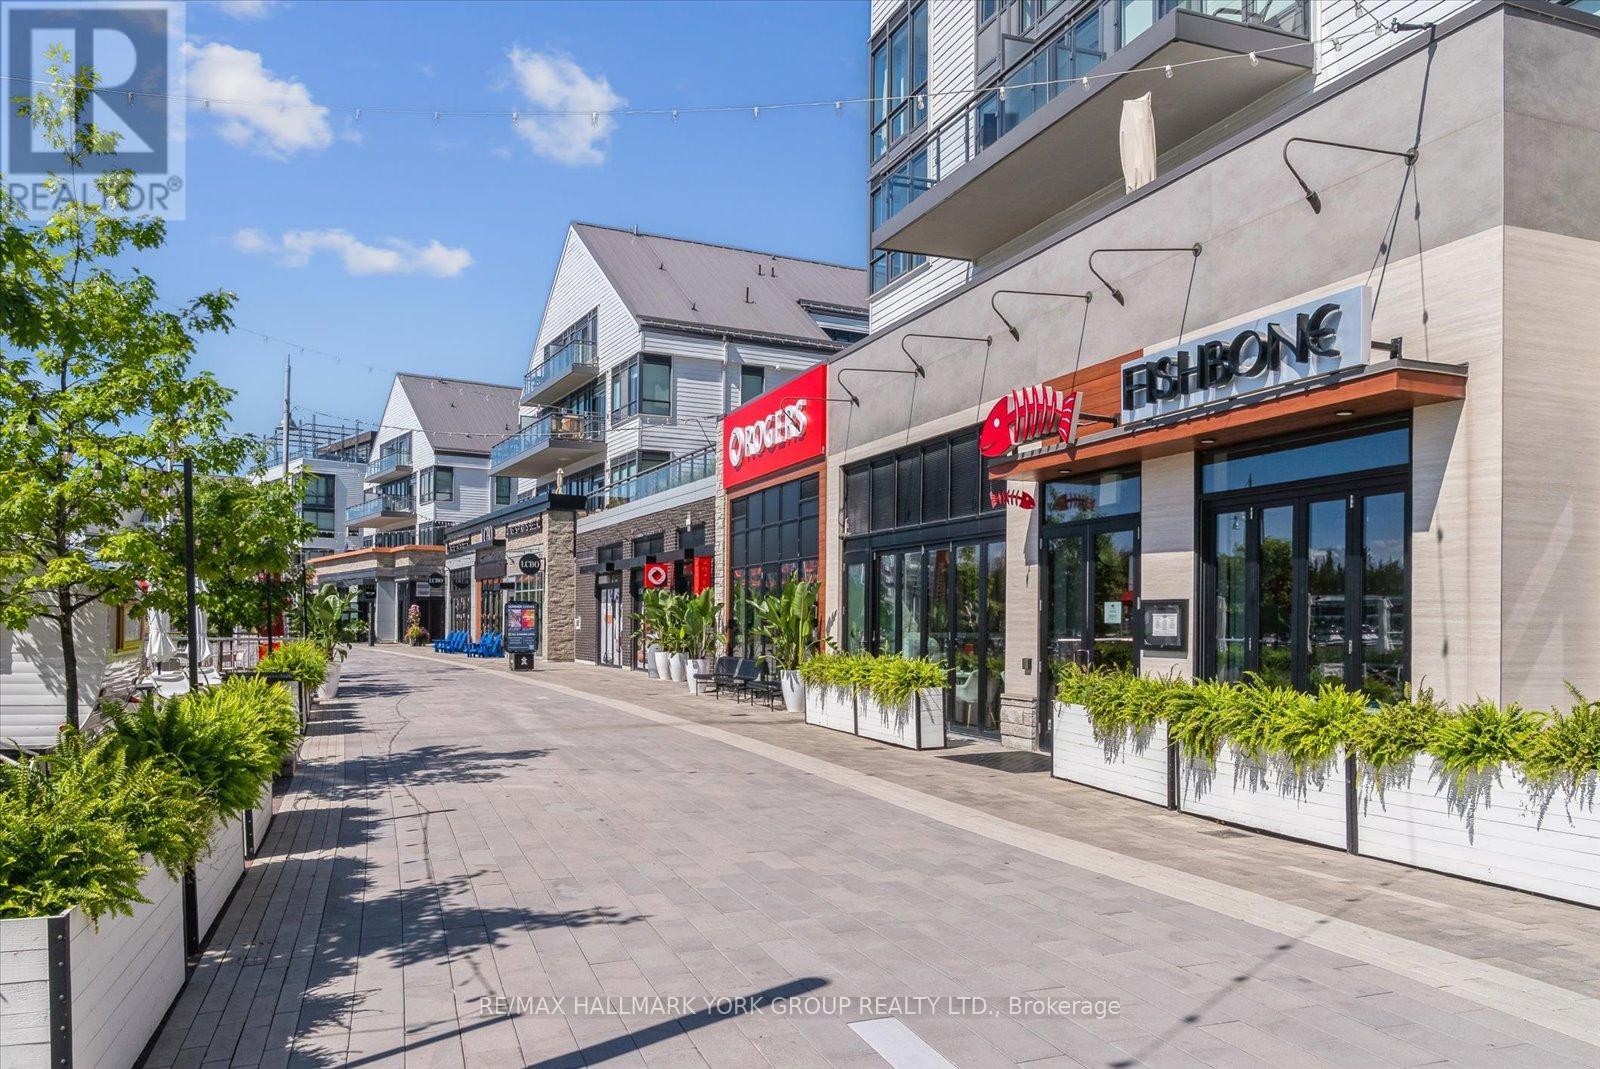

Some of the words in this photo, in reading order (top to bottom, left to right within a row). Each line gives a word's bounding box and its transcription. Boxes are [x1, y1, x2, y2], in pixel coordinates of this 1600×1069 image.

[1122, 302, 1342, 411] FISHBONE
[744, 399, 808, 458] ROGERS
[520, 559, 540, 568] LCBO
